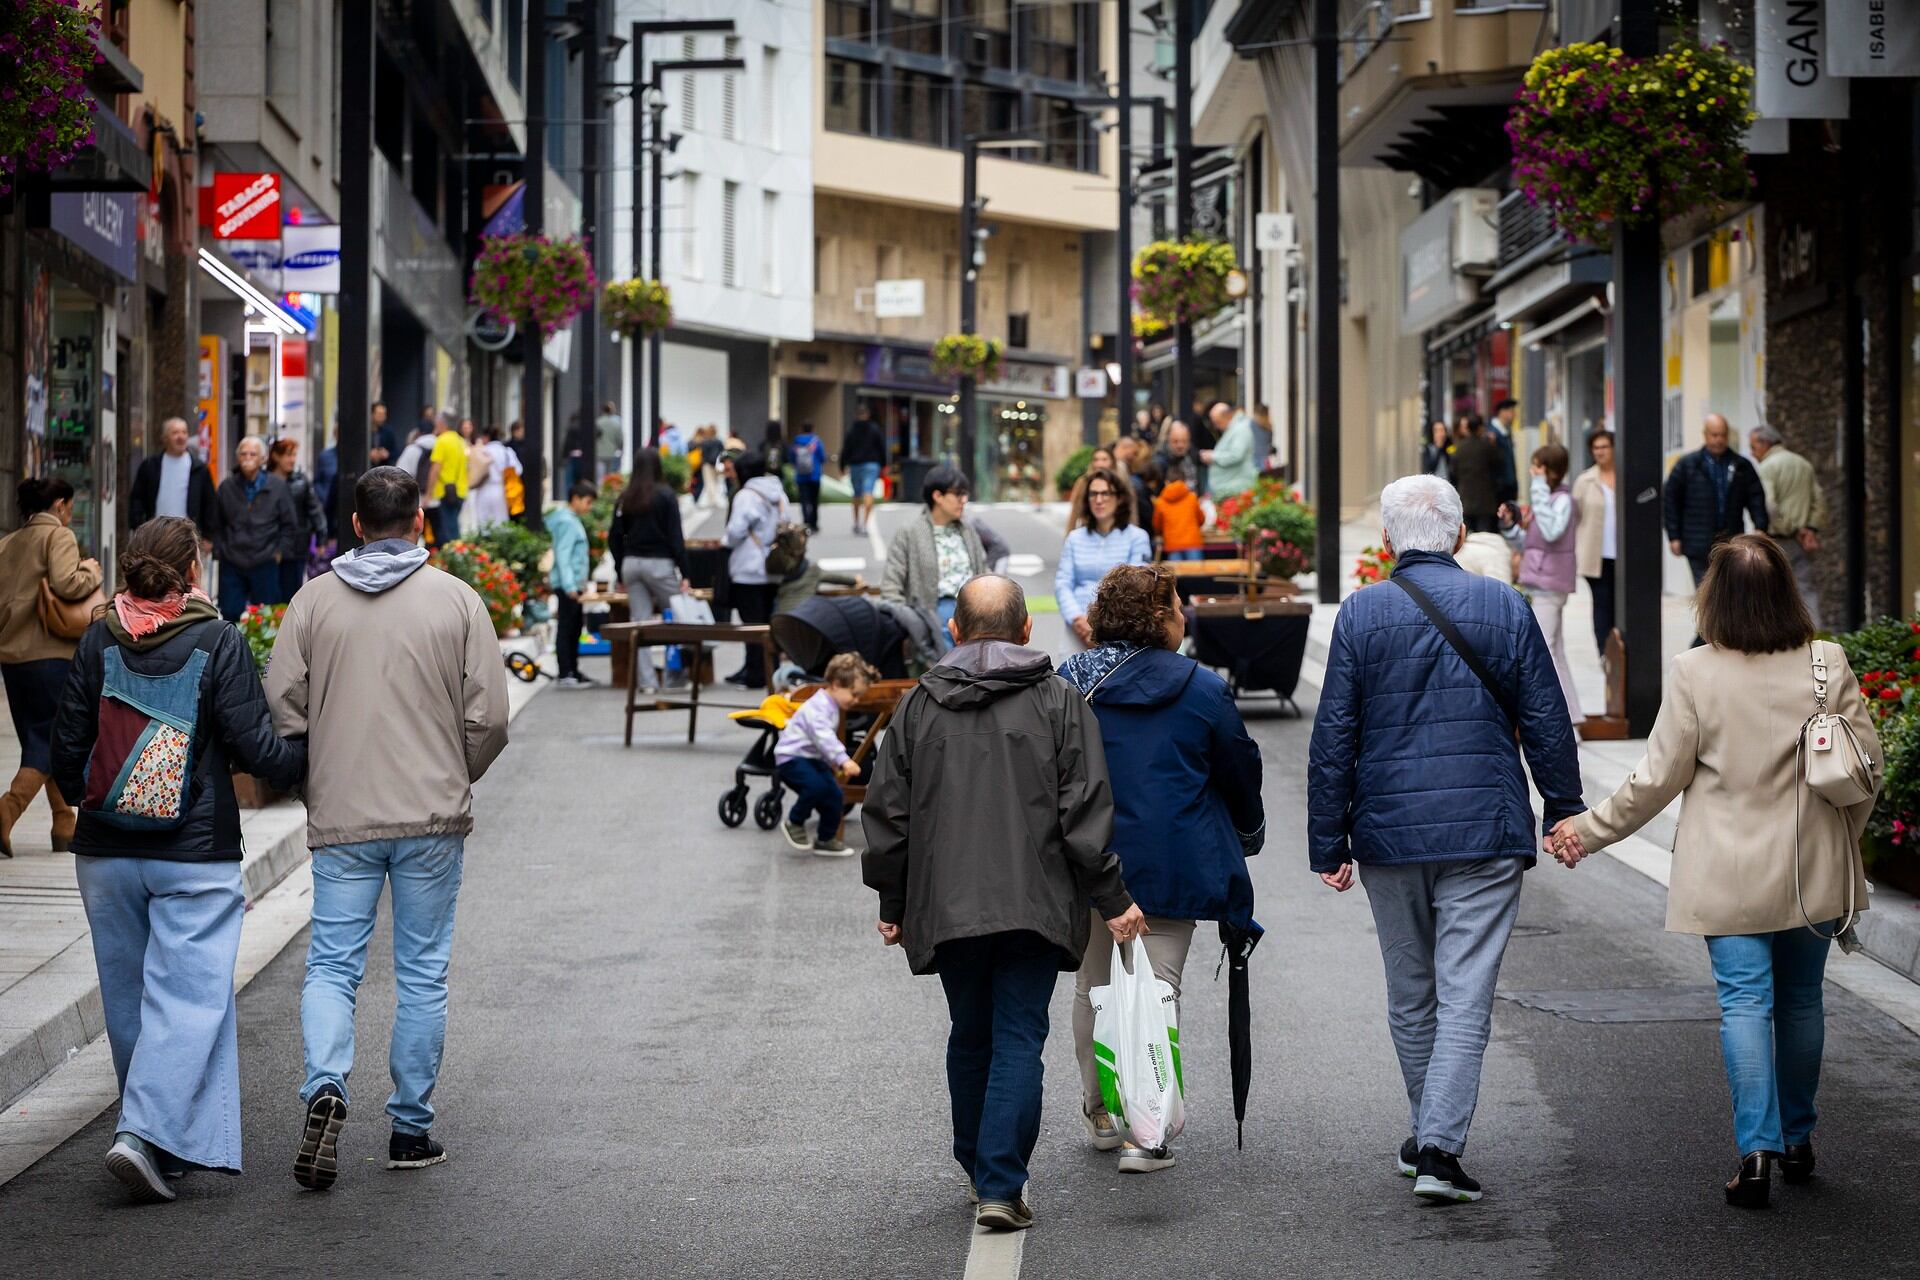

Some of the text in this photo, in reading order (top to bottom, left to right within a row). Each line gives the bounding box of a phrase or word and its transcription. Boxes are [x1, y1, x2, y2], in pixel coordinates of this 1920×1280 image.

[1786, 0, 1819, 87] GAN
[217, 174, 274, 218] TABACS
[1147, 1042, 1157, 1066] online
[1153, 1066, 1166, 1093] compra
